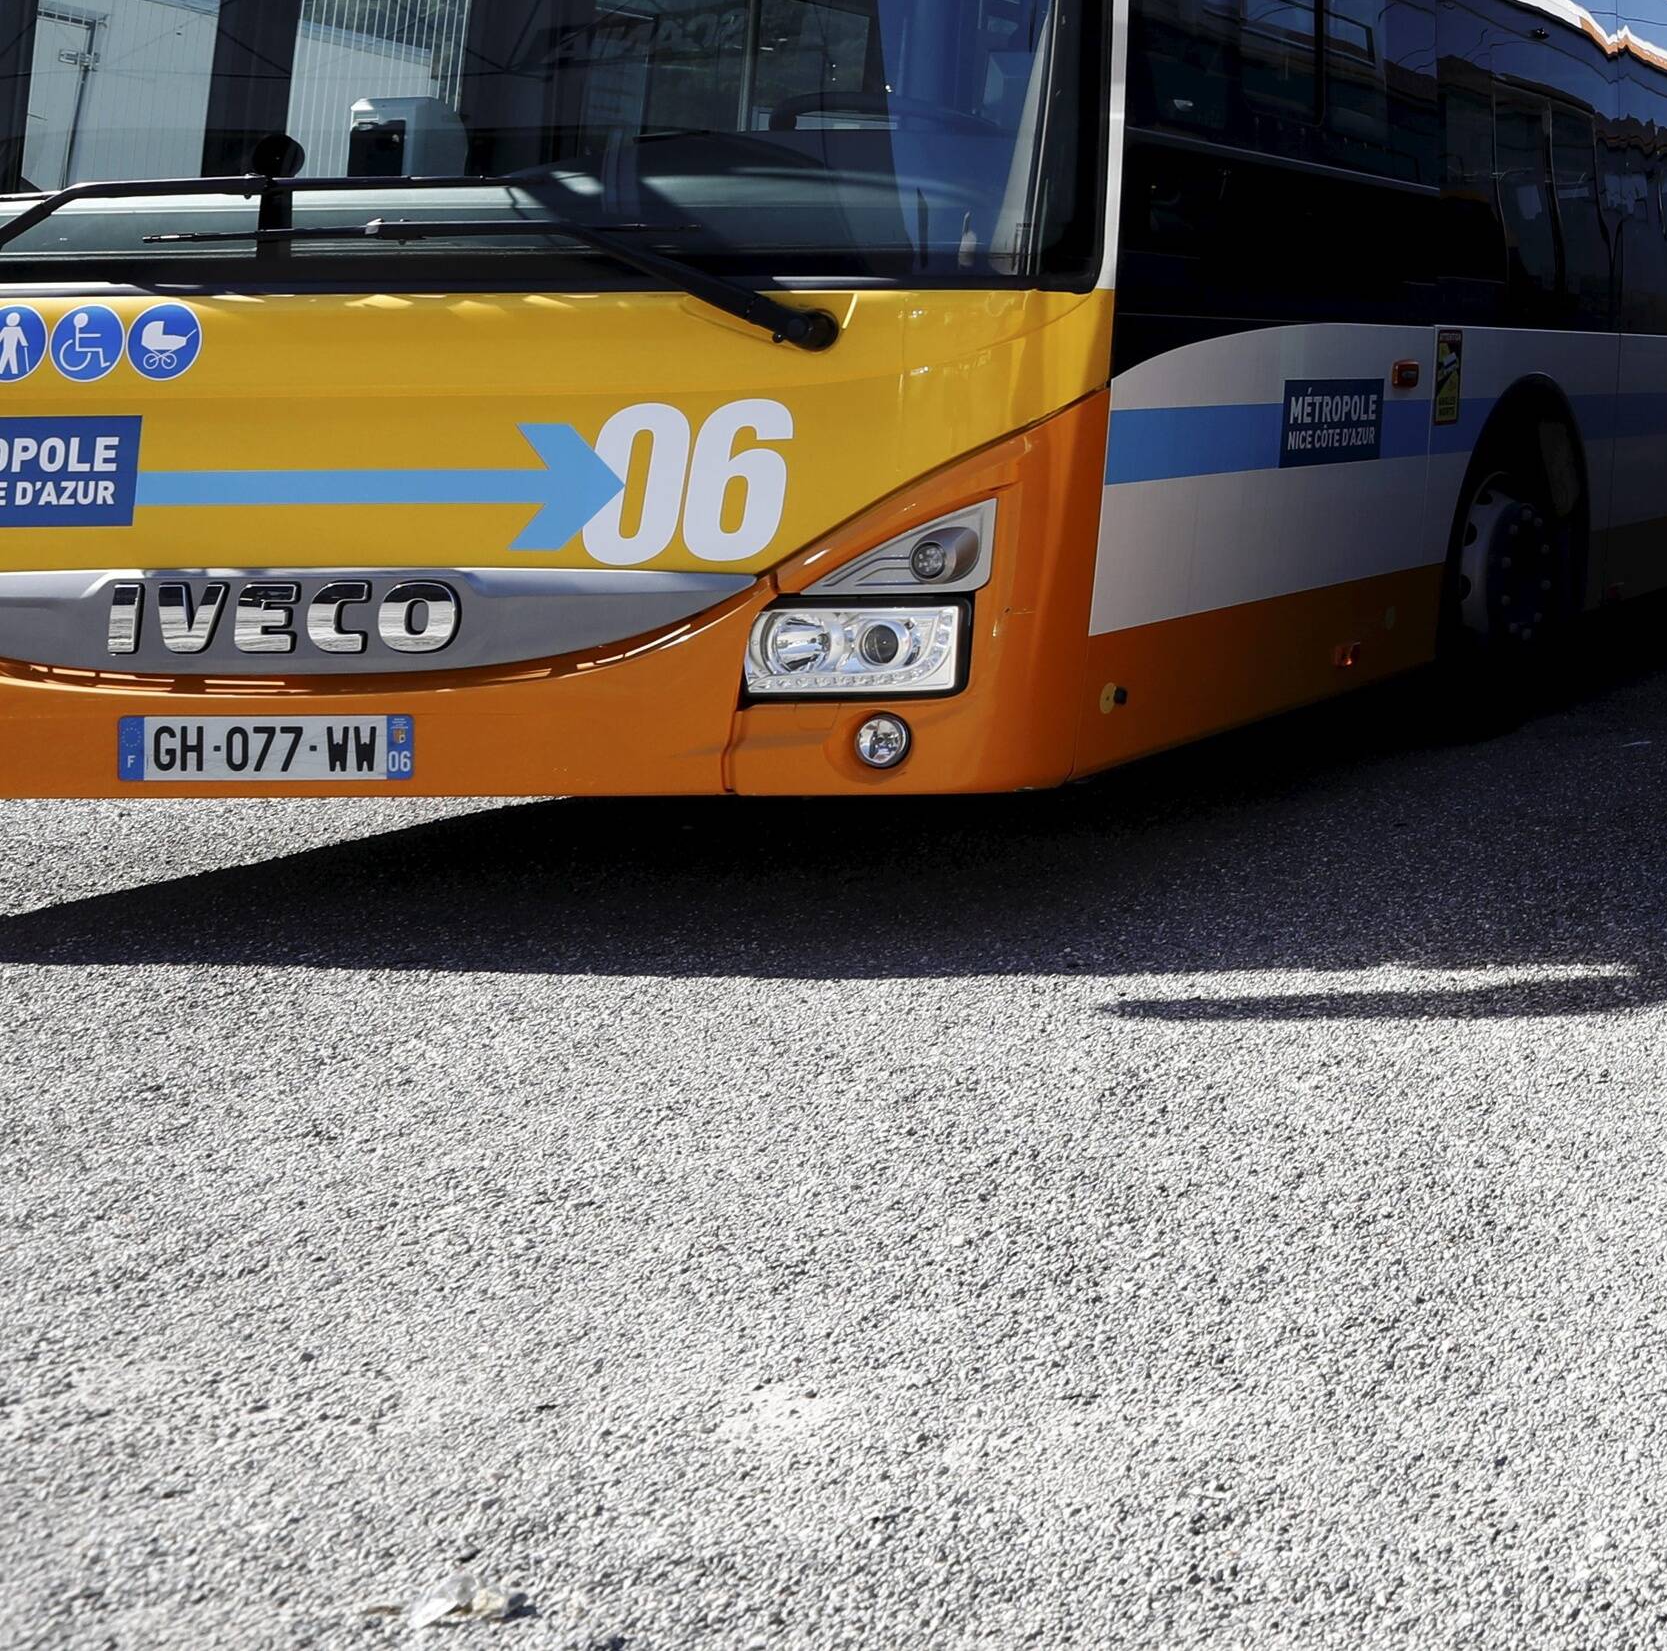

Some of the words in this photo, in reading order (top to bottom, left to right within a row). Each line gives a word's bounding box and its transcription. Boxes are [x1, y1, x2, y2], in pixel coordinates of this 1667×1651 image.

[1290, 387, 1377, 424] MÉTROPOLE
[1288, 431, 1312, 450] NICE
[1314, 424, 1340, 448] CÔTE
[1341, 427, 1375, 447] D'AZUR
[15, 481, 115, 505] D'AZUR
[582, 399, 794, 566] 06
[107, 580, 461, 656] IVECO
[127, 755, 135, 768] F
[153, 726, 377, 772] GH-077-WW
[388, 751, 411, 772] 06
